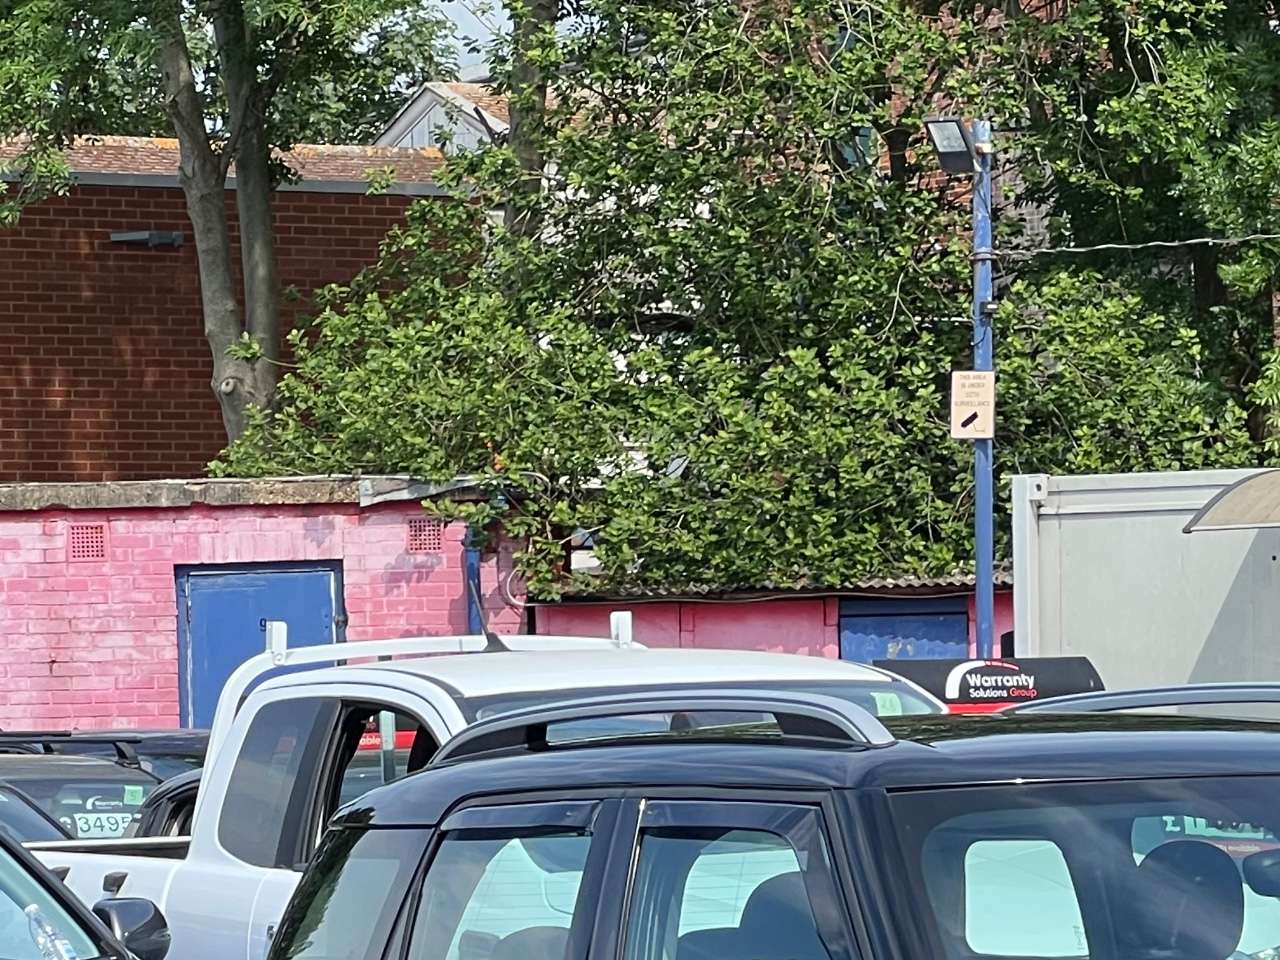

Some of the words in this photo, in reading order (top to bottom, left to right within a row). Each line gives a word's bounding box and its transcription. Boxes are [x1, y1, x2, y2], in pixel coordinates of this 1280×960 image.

[966, 673, 1034, 689] Warranty
[969, 688, 1008, 698] Solutions
[1009, 687, 1038, 699] Group
